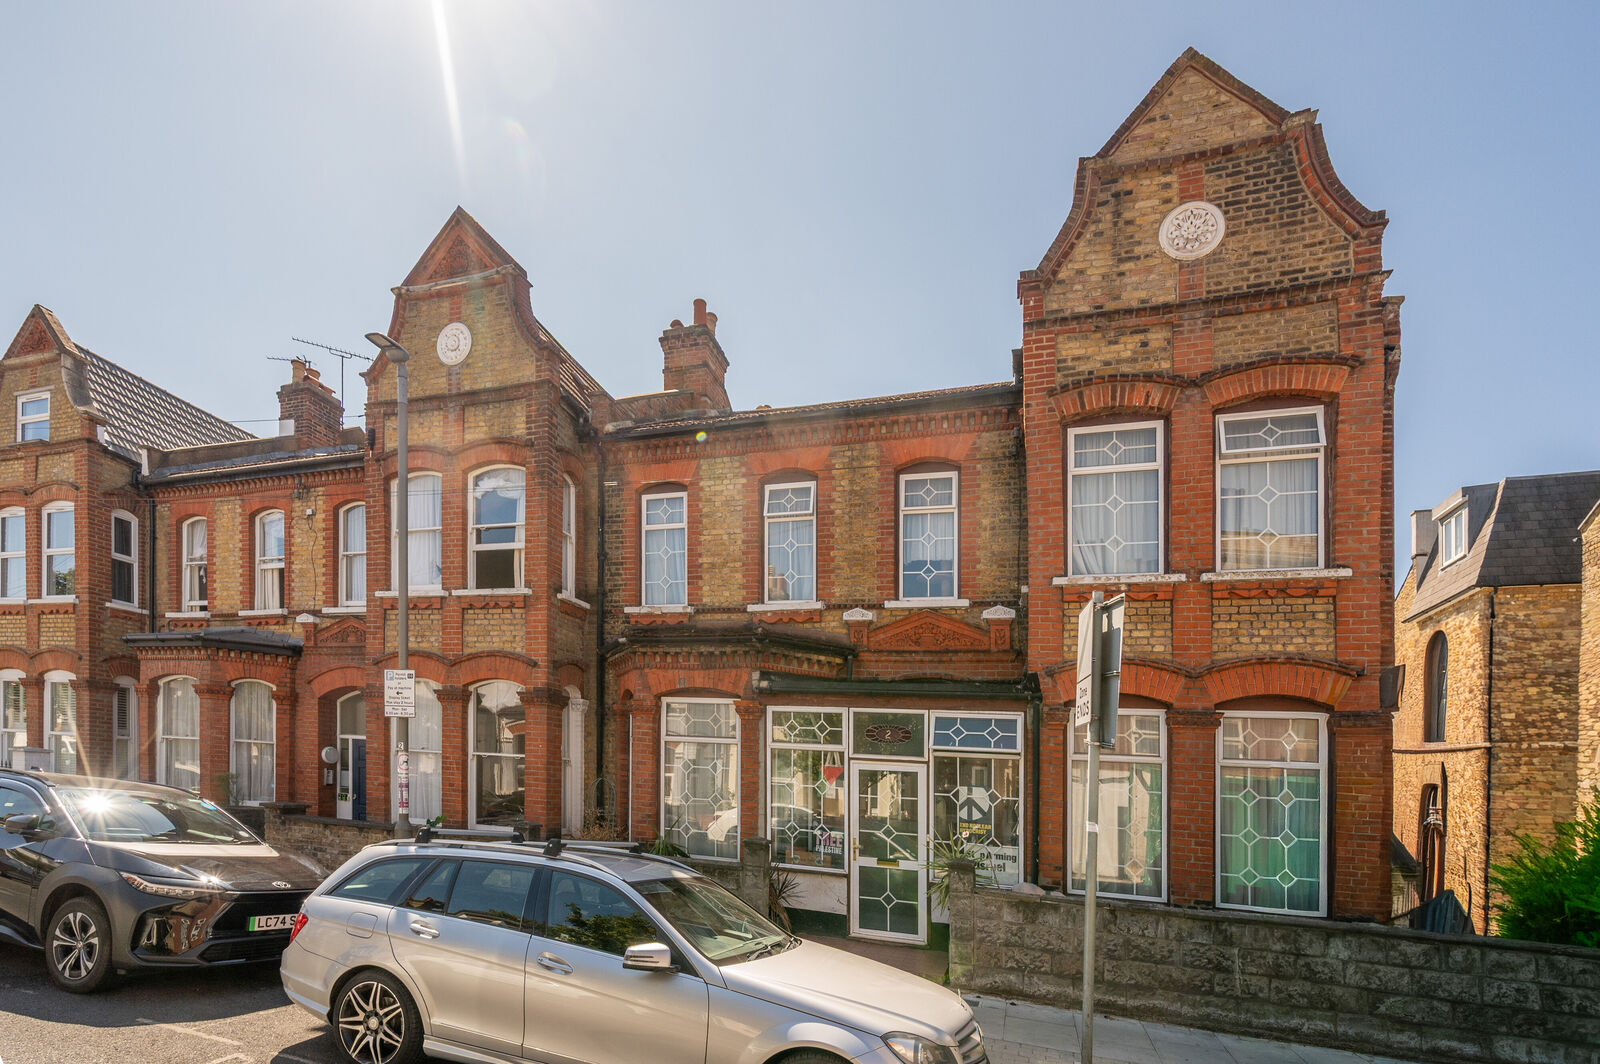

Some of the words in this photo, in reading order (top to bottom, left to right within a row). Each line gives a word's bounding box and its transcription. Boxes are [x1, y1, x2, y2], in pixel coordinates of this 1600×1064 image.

[1077, 700, 1089, 719] ENDS
[885, 730, 891, 740] 2
[815, 845, 843, 854] PAESTINE
[257, 916, 287, 928] LC74
